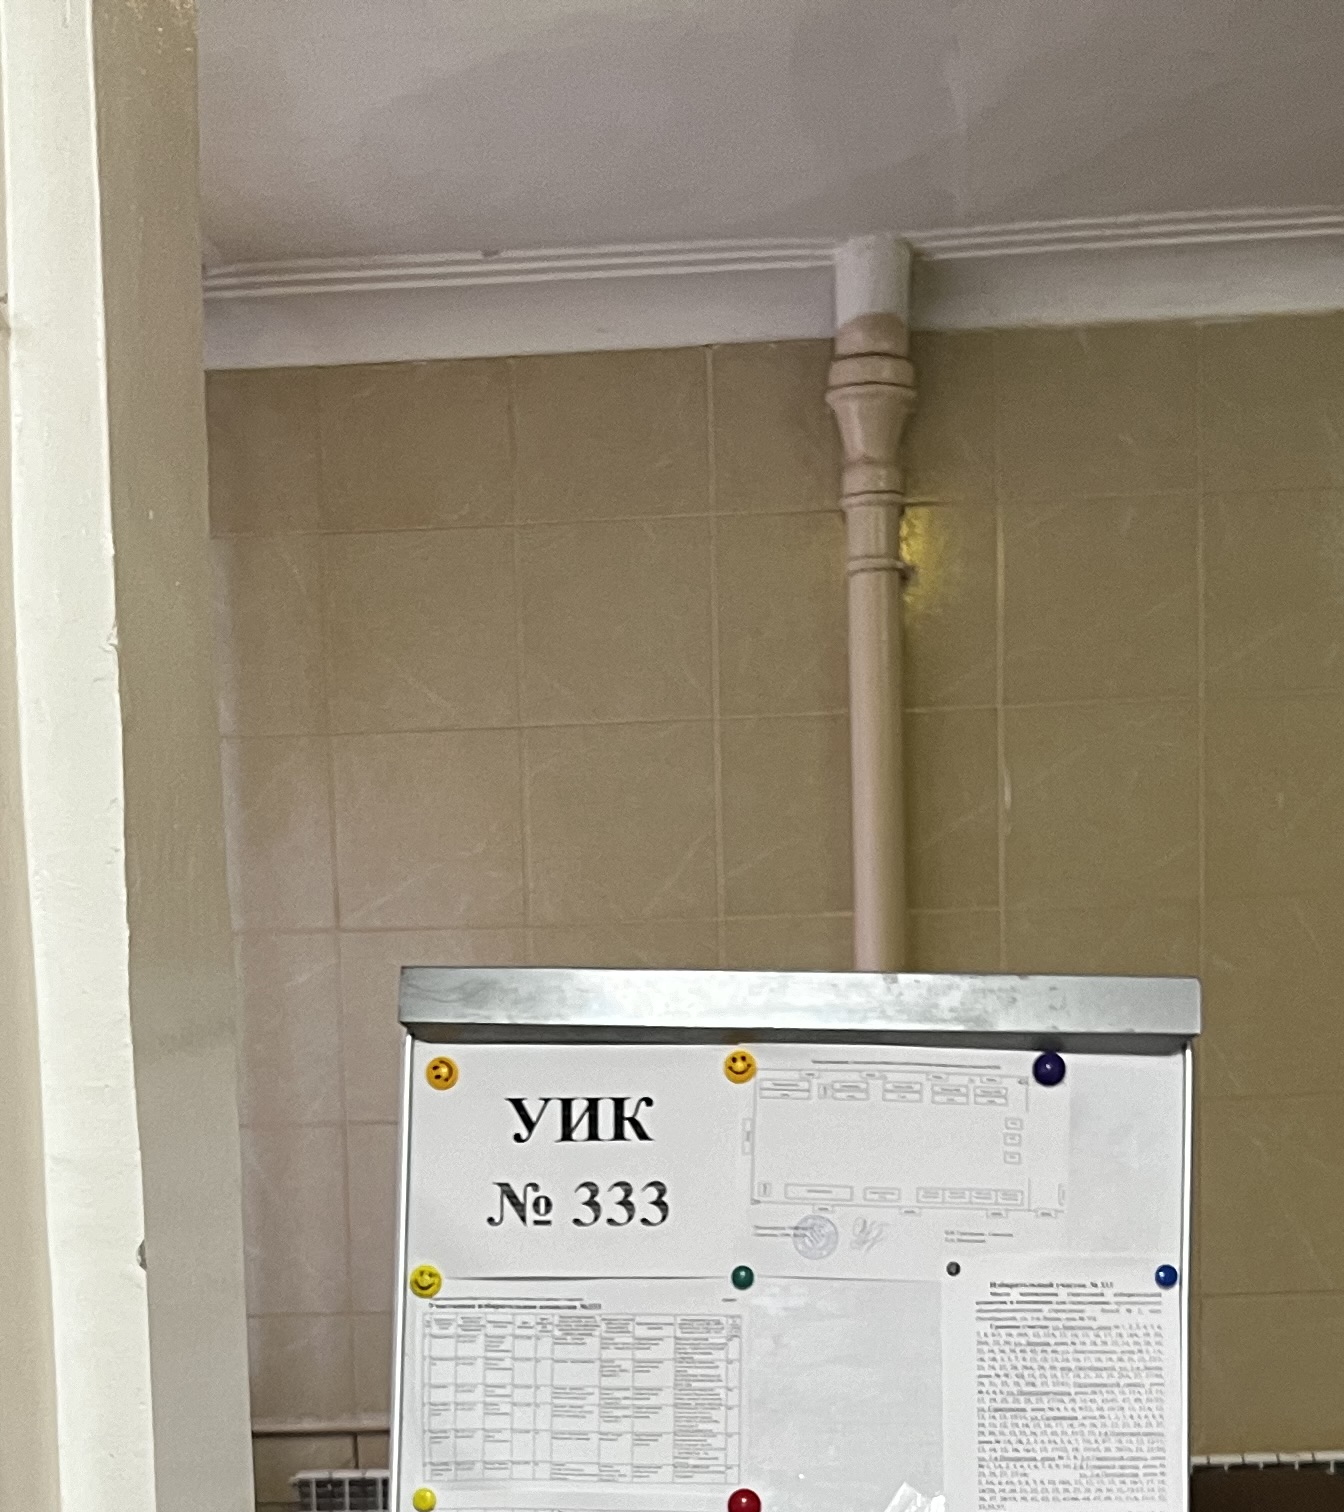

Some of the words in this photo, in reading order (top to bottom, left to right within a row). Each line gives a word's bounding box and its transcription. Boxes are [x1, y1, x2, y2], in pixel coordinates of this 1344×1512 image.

[504, 1096, 655, 1144] УИК
[486, 1181, 554, 1228] №
[571, 1180, 670, 1228] 333
